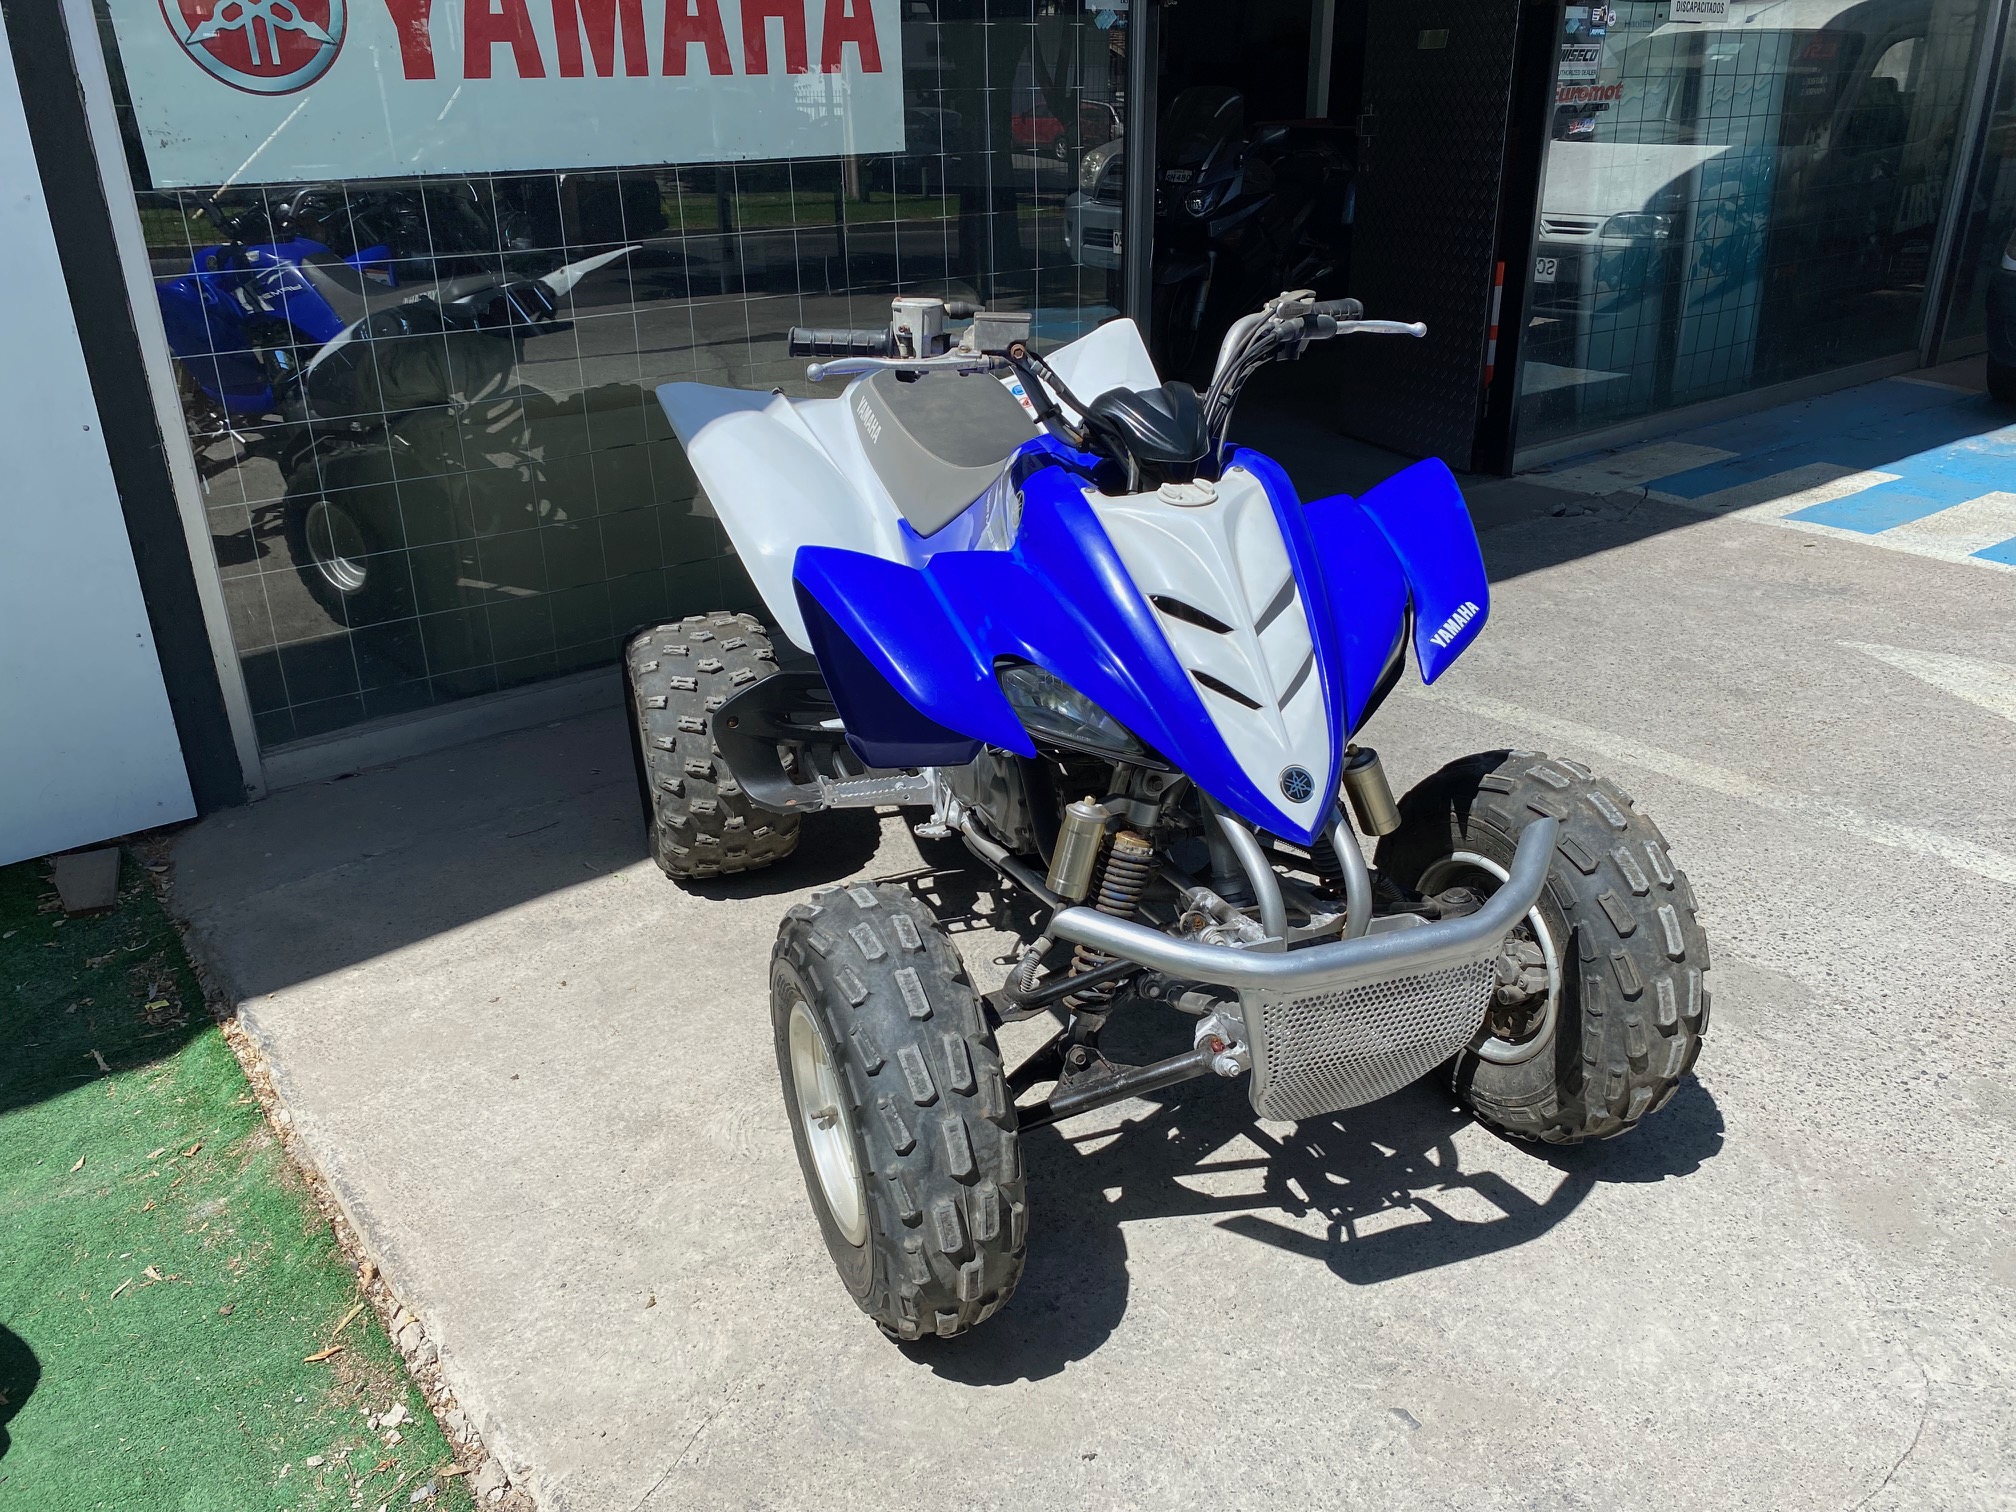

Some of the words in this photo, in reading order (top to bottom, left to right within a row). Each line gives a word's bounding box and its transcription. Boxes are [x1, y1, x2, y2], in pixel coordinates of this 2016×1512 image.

[1675, 1, 1725, 14] DISCAPACITADOS
[380, 0, 883, 79] YAMAHA
[856, 395, 881, 444] YAMAHA
[1429, 601, 1480, 648] YAMAHA
